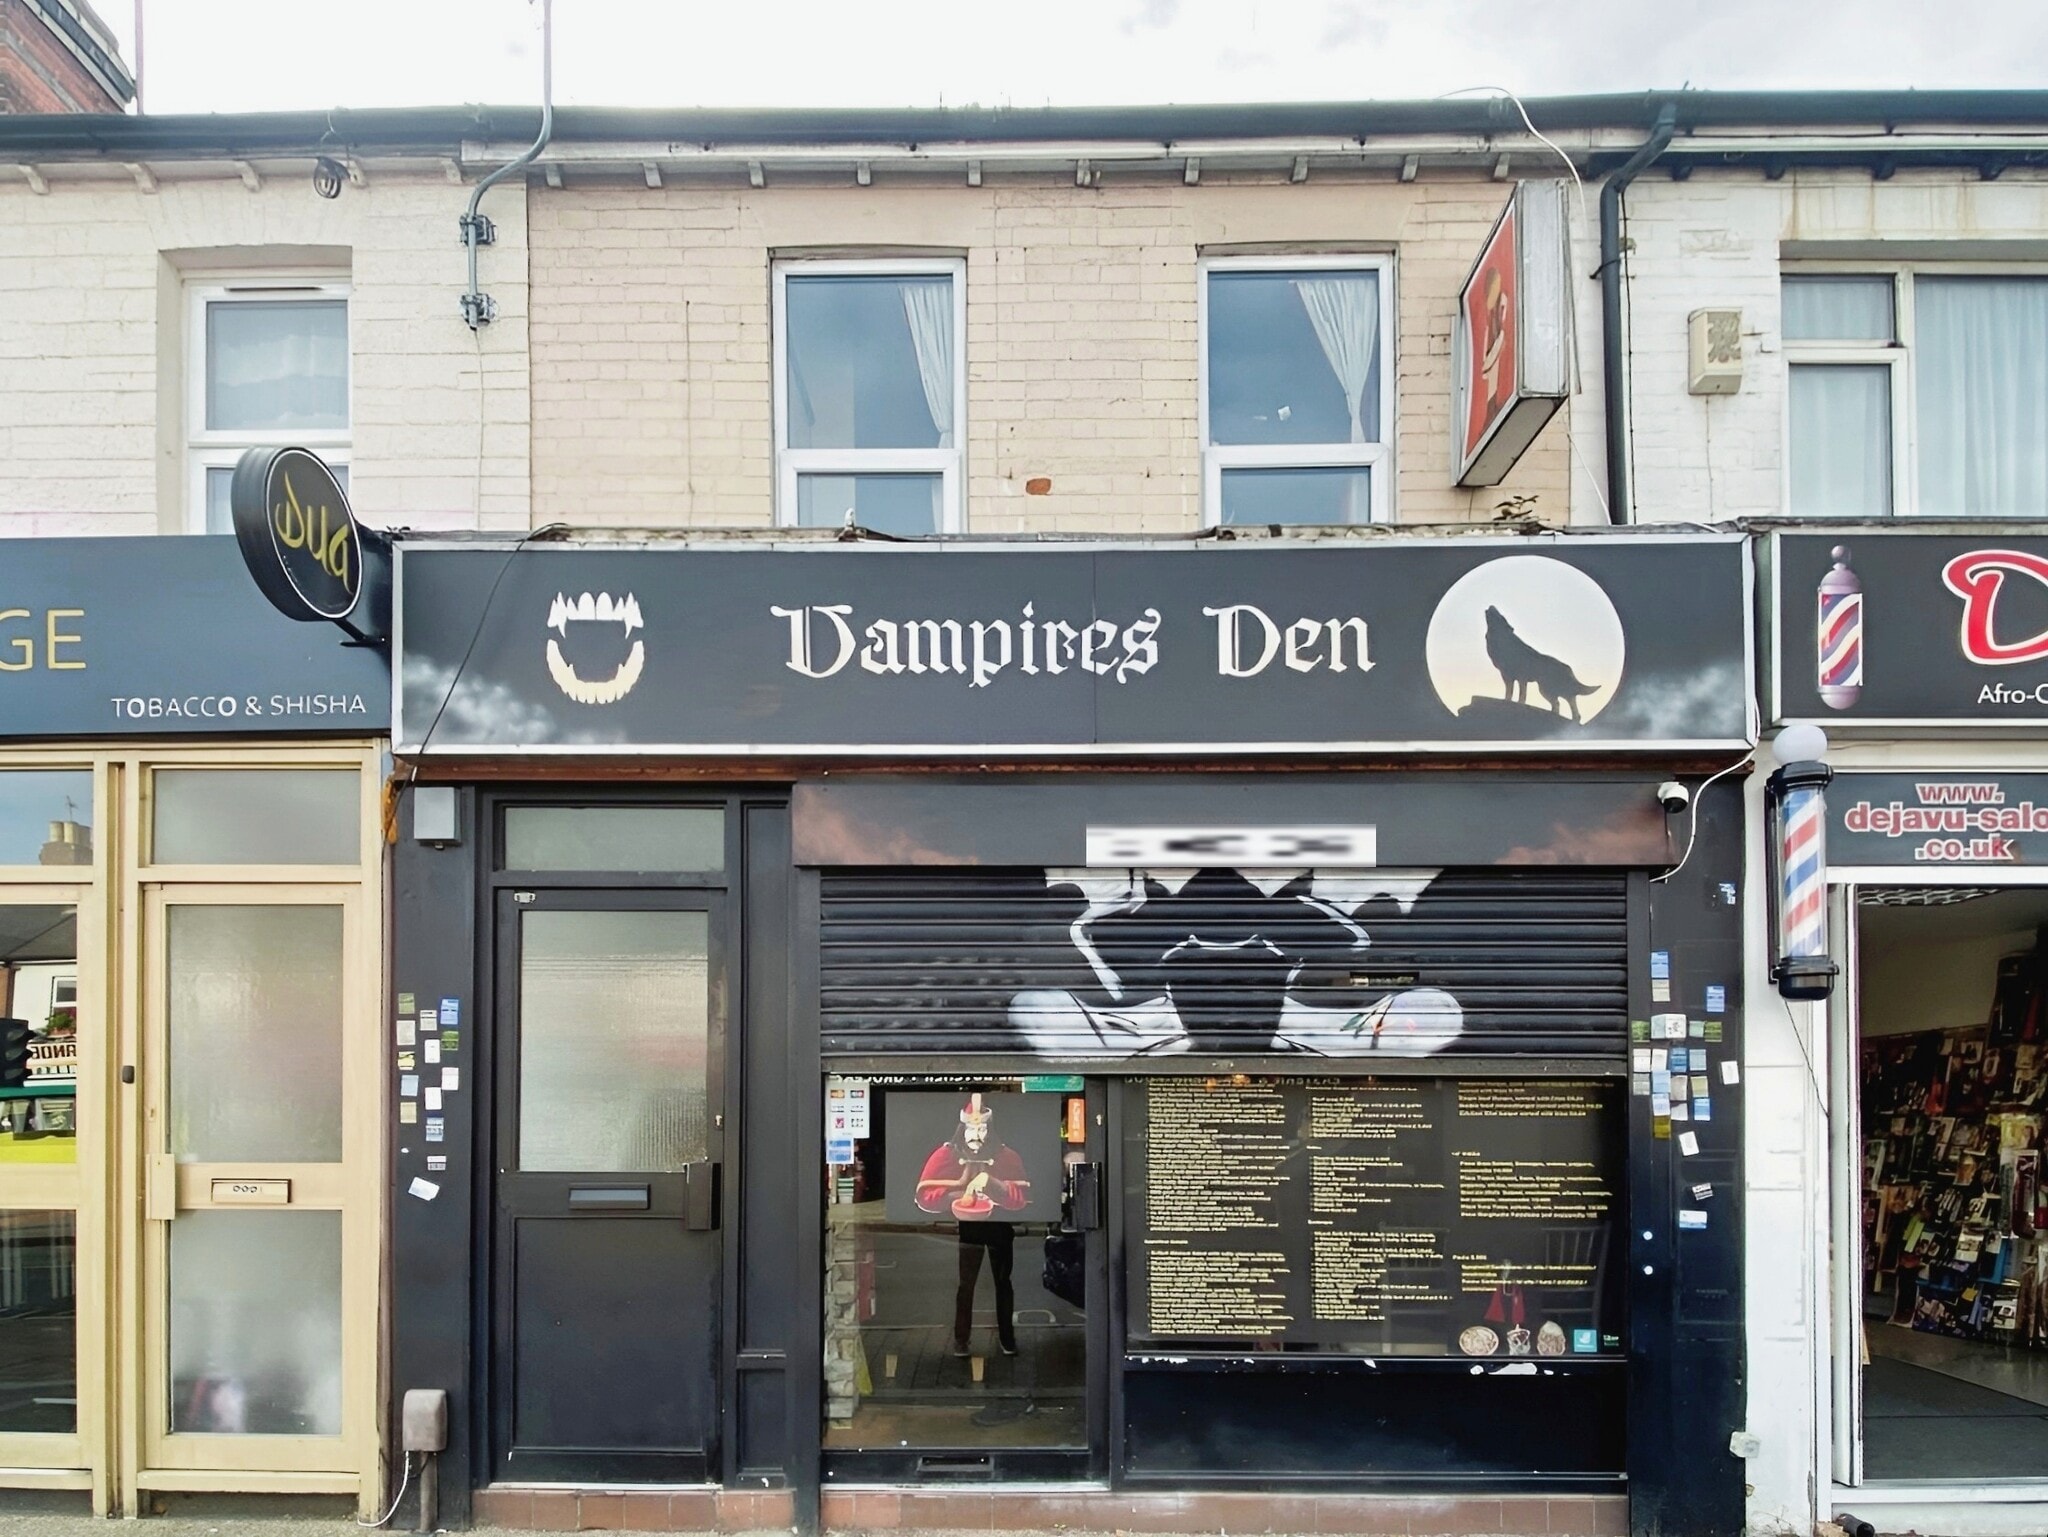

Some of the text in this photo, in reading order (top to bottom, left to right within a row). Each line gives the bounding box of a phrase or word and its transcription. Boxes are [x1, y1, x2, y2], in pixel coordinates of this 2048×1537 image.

[769, 601, 1376, 688] Vampires Den
[111, 694, 366, 719] TOBACCO & SHISHA
[1915, 783, 2005, 804] www.
[1915, 833, 2014, 860] .co.uk
